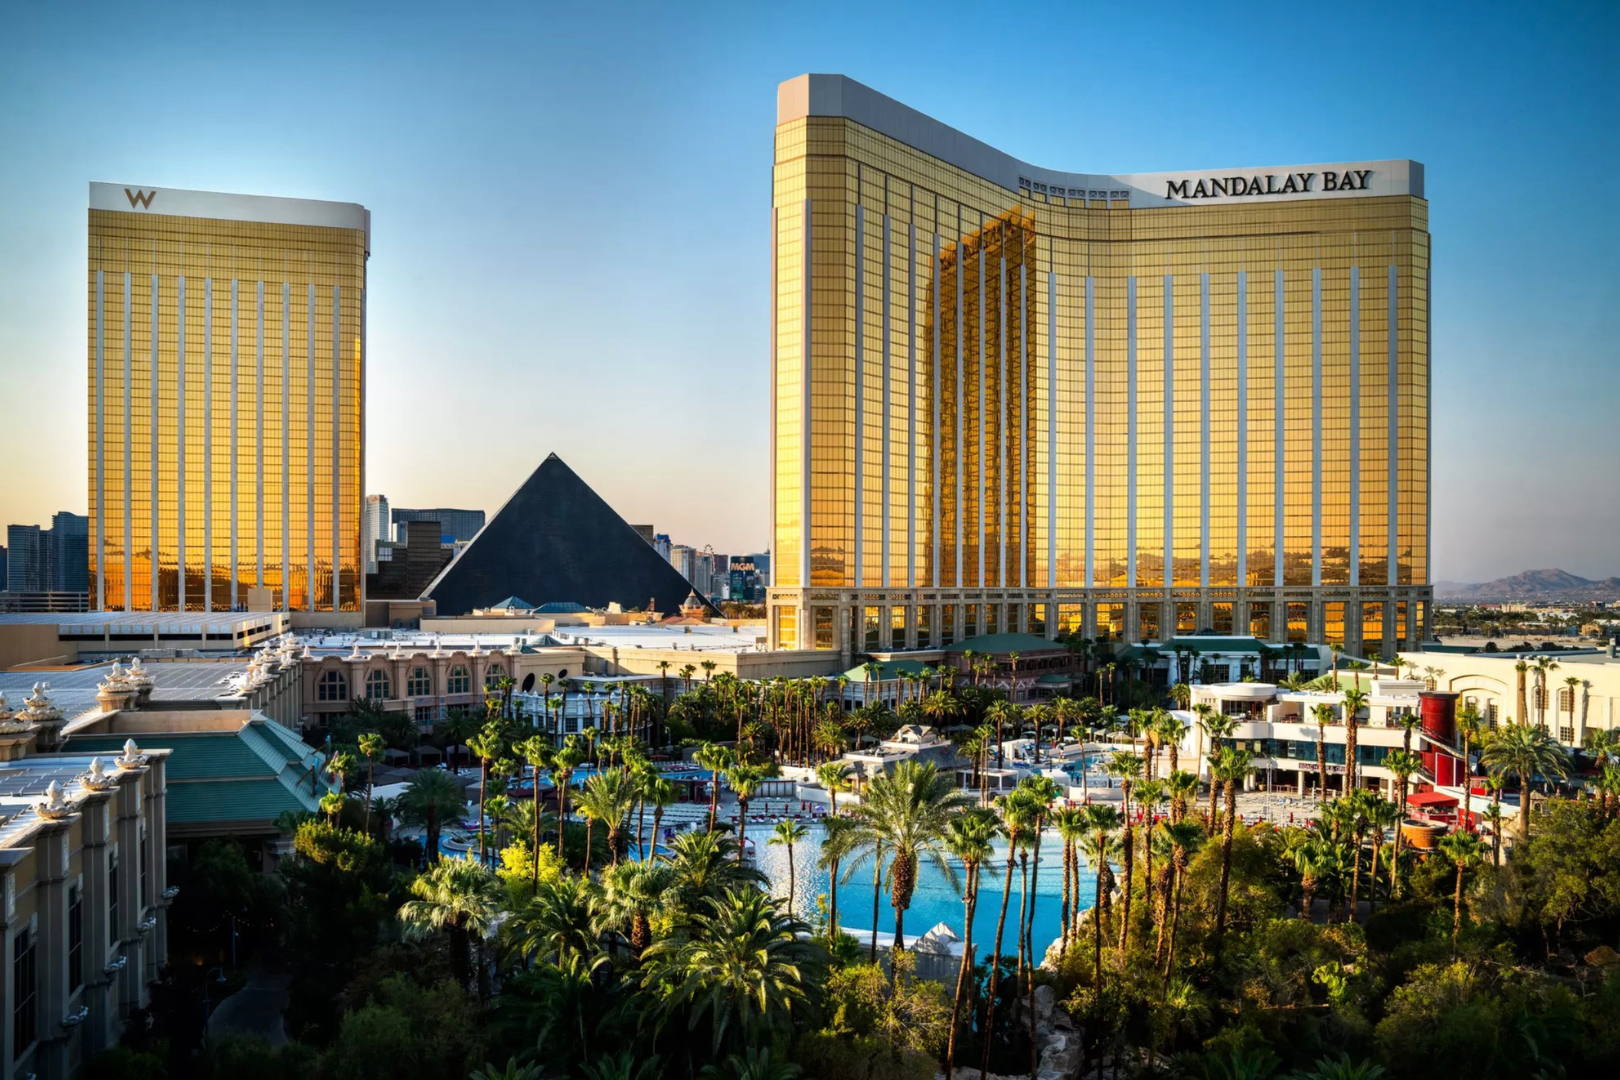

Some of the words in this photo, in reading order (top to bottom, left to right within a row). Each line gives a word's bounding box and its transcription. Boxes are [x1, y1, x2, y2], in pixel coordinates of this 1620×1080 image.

[1165, 173, 1314, 199] MANDALAY
[1322, 170, 1371, 191] BAY
[124, 188, 156, 210] W
[731, 563, 755, 571] MGM
